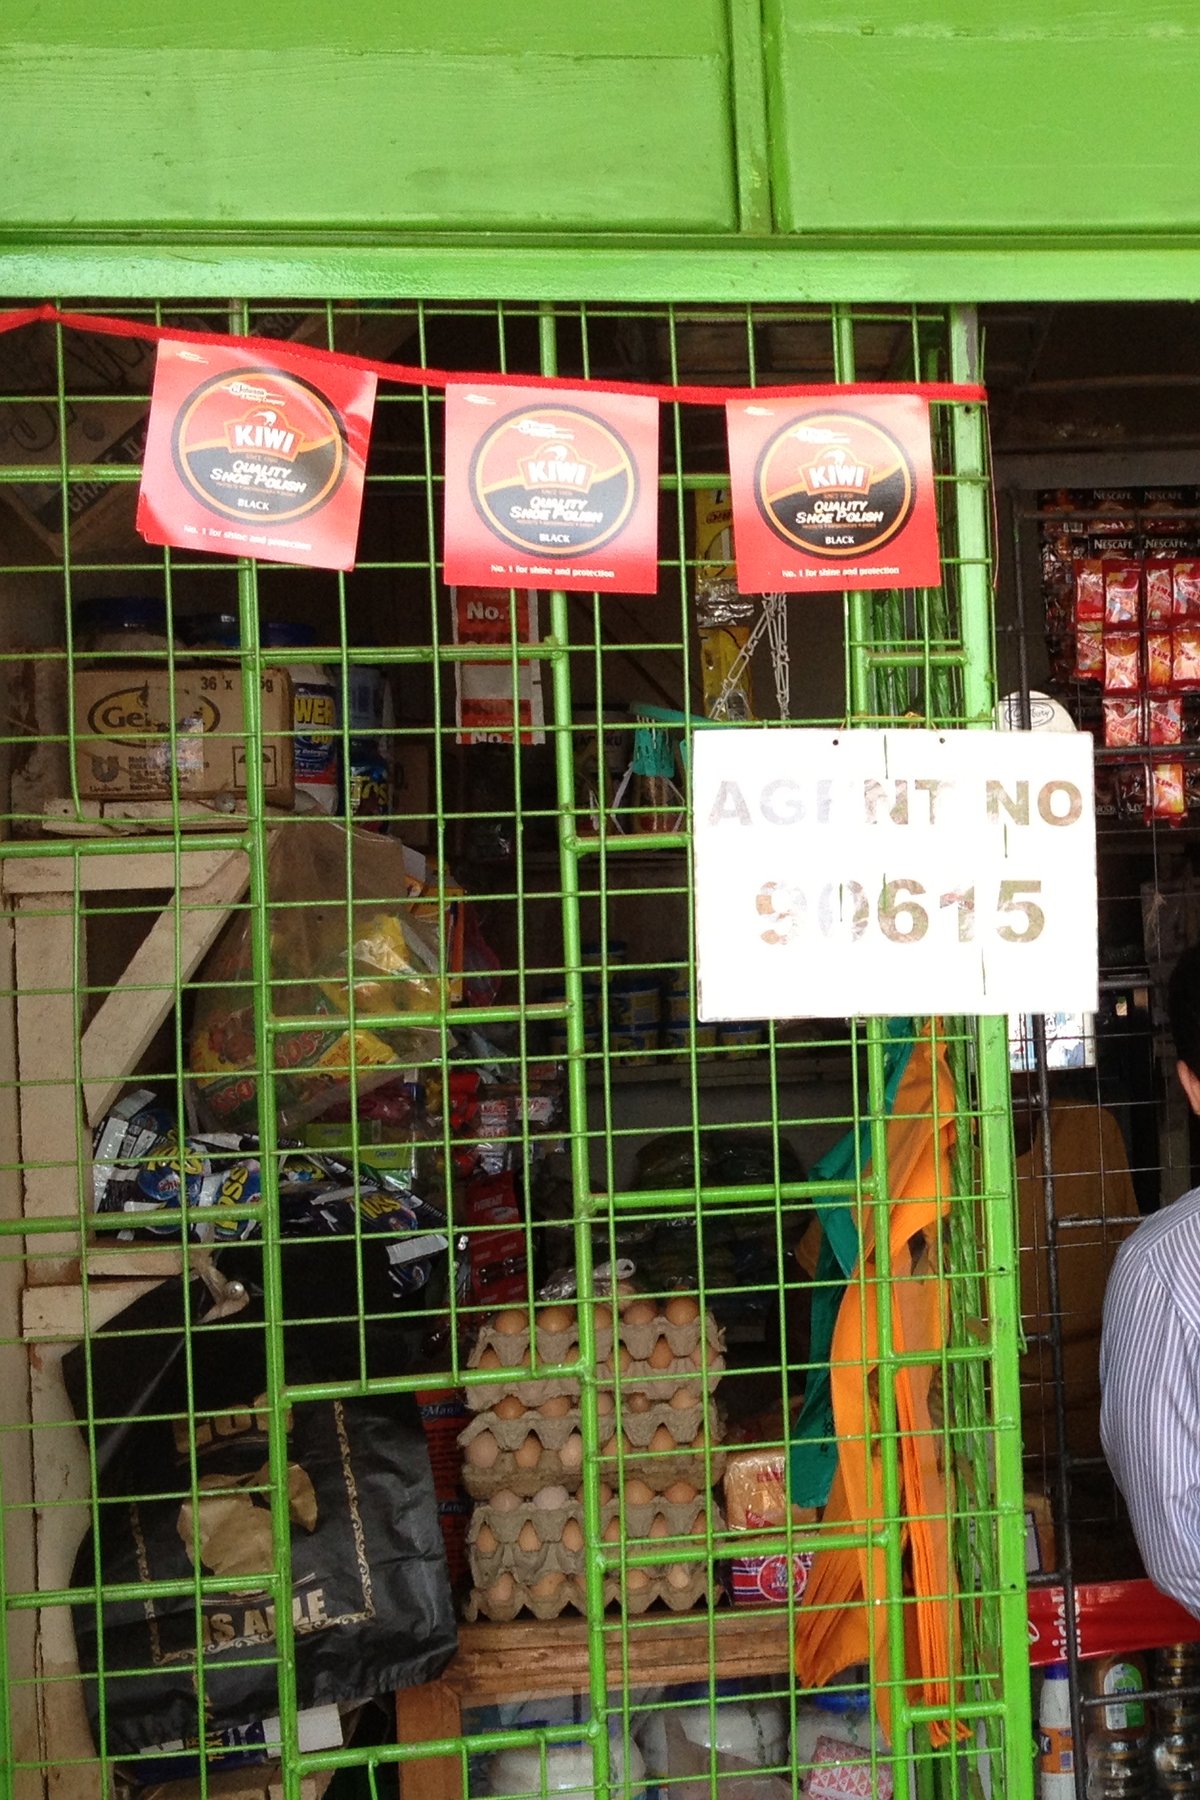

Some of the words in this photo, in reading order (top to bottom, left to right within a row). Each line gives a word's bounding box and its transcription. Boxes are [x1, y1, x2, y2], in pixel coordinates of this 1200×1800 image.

[234, 425, 294, 454] KIWI
[232, 460, 292, 479] QUALITY
[528, 460, 586, 486] KIWI
[808, 464, 865, 488] KIWI
[210, 468, 254, 486] SHOE
[254, 473, 307, 493] POLISH
[238, 498, 270, 511] BLACK
[529, 496, 588, 511] QUALITY
[814, 500, 868, 514] QUALITY
[510, 506, 550, 521] SHOE
[551, 507, 604, 523] POLISH
[795, 511, 834, 524] SHOE
[836, 508, 884, 523] POLISH
[538, 533, 570, 544] BLACK
[824, 536, 855, 545] BLACK
[490, 564, 505, 573] No.
[515, 565, 528, 574] for
[530, 566, 553, 575] shine
[554, 568, 571, 576] and
[572, 568, 615, 578] protection
[782, 569, 796, 578] No.
[805, 568, 817, 577] for
[818, 568, 841, 576] shine
[842, 568, 858, 576] and
[859, 567, 900, 577] protection
[200, 676, 218, 690] 36
[985, 779, 1083, 827] NO
[754, 878, 1046, 945] 90615
[243, 1587, 330, 1638] ALE
